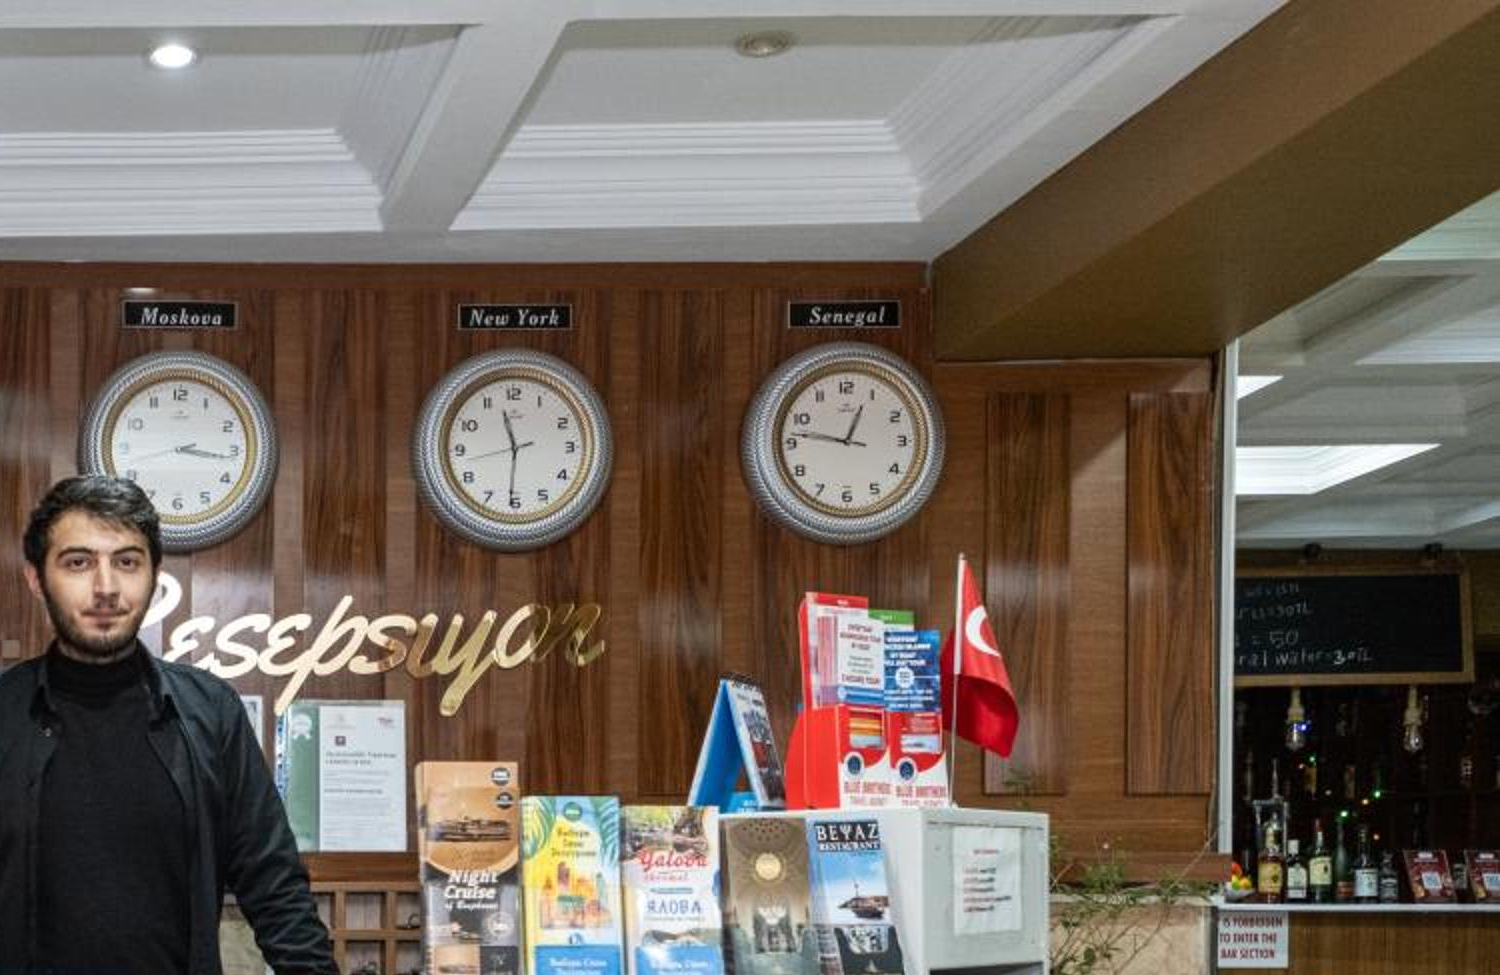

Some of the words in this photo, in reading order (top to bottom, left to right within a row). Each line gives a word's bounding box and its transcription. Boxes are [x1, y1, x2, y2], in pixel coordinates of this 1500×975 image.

[141, 307, 223, 325] Moskova
[469, 308, 509, 327] New
[517, 308, 560, 327] York
[808, 305, 885, 327] Senegal
[506, 387, 521, 400] 12
[839, 381, 854, 394] 12
[173, 388, 188, 401] 12
[815, 390, 824, 403] 11
[870, 389, 875, 401] 1
[149, 397, 159, 409] 11
[203, 398, 208, 410] 1
[483, 397, 492, 409] 11
[537, 395, 542, 408] 1
[557, 417, 568, 429] 2
[794, 413, 810, 425] 10
[890, 411, 900, 423] 2
[127, 418, 143, 430] 10
[222, 420, 233, 433] 2
[462, 420, 478, 432] 10
[786, 437, 797, 450] 9
[897, 435, 907, 447] 3
[230, 445, 239, 457] 3
[455, 444, 465, 456] 9
[565, 441, 575, 454] 3
[557, 469, 568, 480] 4
[795, 465, 805, 477] 8
[889, 463, 899, 474] 4
[220, 472, 230, 483] 4
[463, 471, 474, 483] 8
[538, 489, 548, 500] 5
[815, 483, 825, 496] 7
[869, 483, 880, 495] 5
[200, 492, 211, 503] 5
[484, 490, 493, 503] 7
[841, 491, 852, 503] 6
[172, 497, 183, 510] 6
[815, 823, 879, 841] BEYAZ
[448, 870, 499, 886] Night
[444, 885, 497, 899] Cruise
[1234, 933, 1259, 943] ENTER
[1262, 933, 1277, 943] THE
